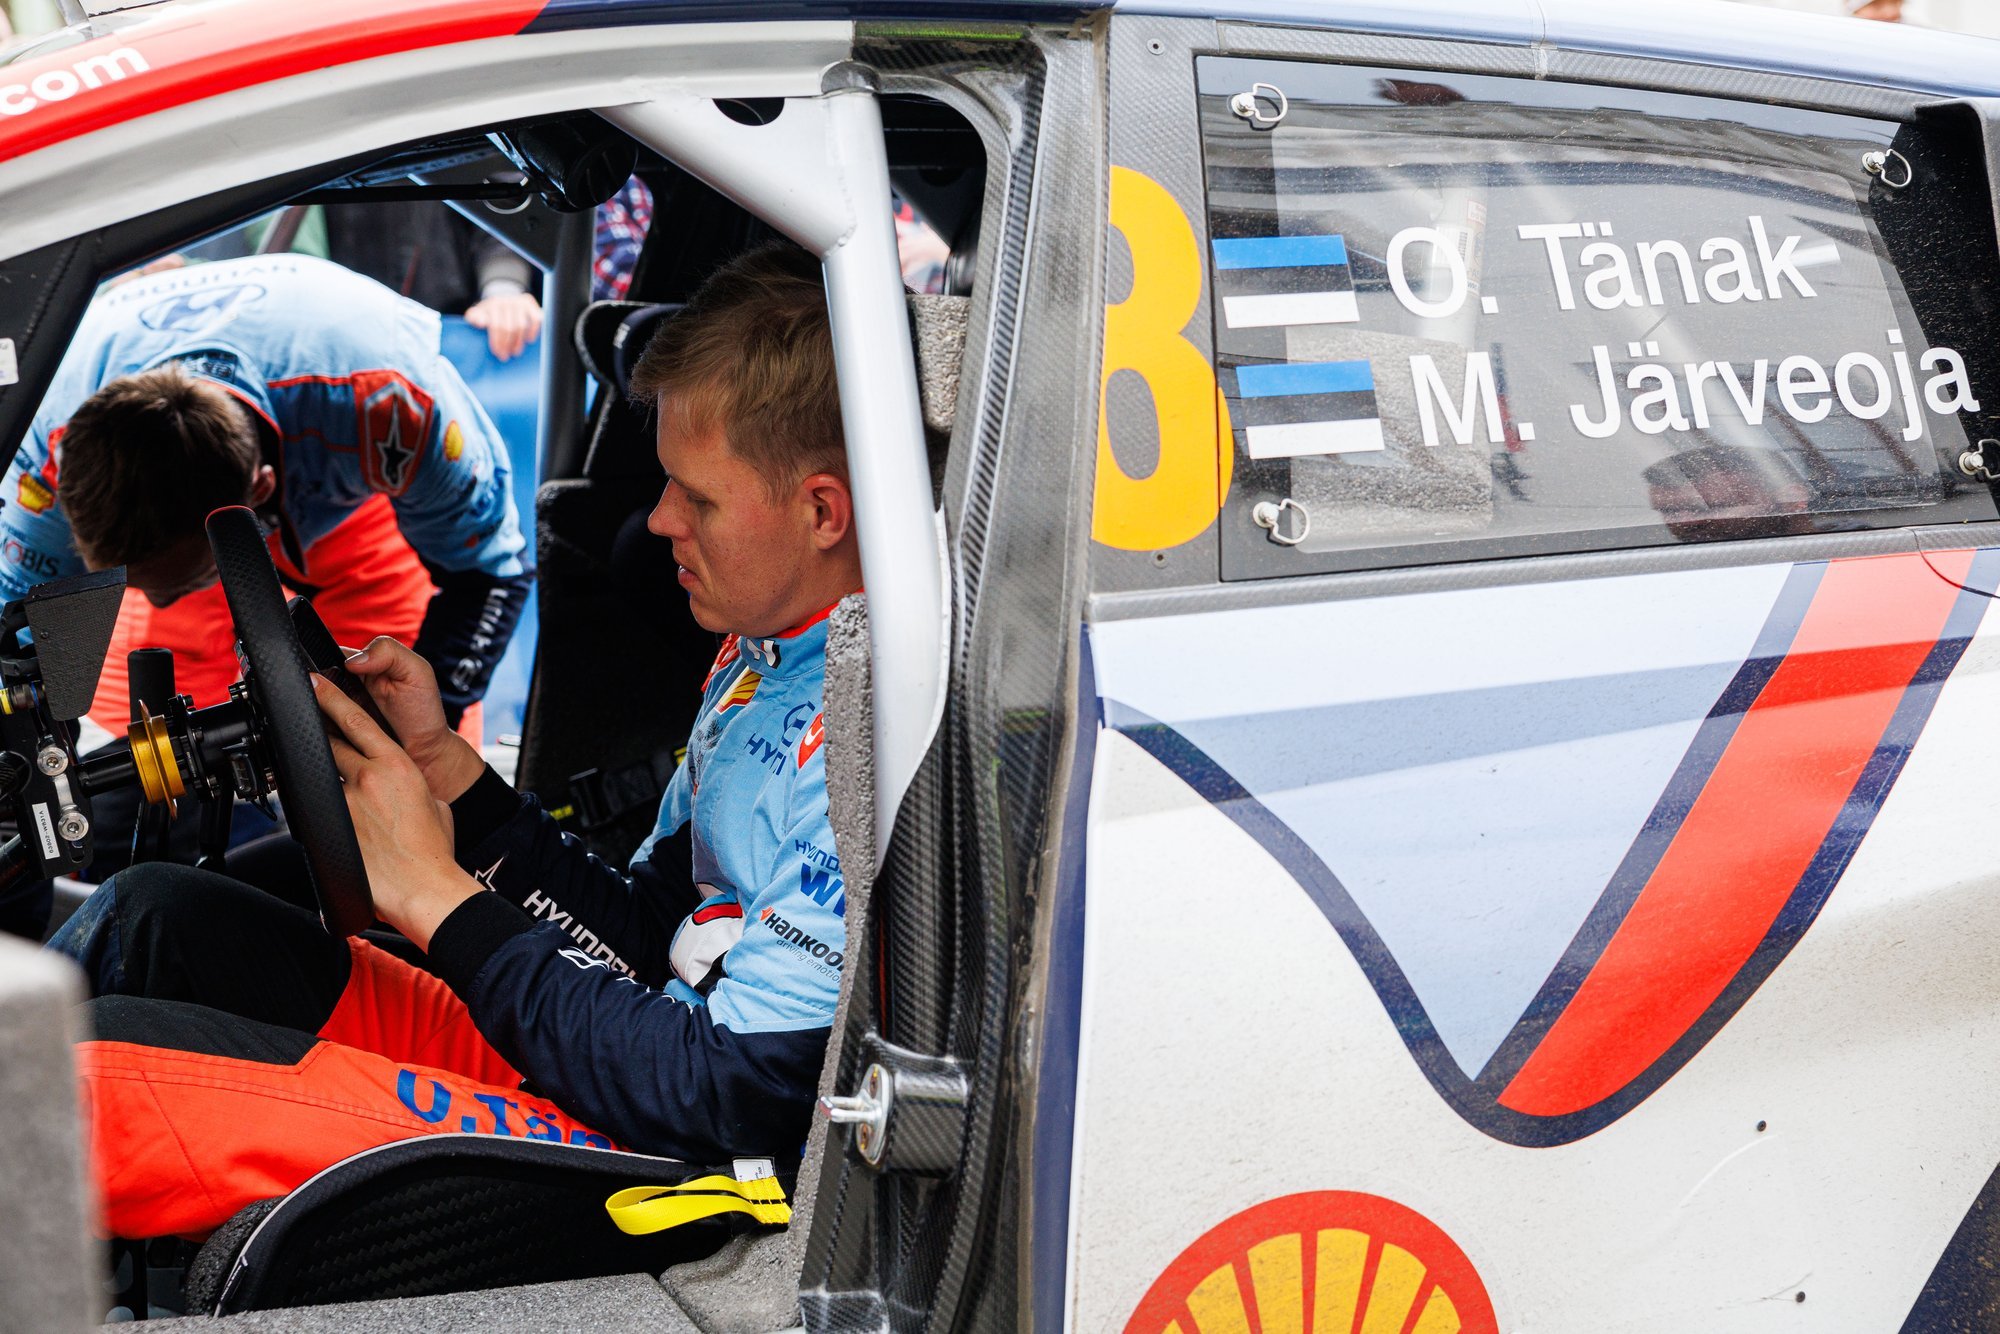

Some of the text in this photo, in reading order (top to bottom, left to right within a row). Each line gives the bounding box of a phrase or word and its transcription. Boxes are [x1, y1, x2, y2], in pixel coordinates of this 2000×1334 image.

[1386, 215, 1818, 318] O. Tänak
[1410, 329, 1981, 448] M. Järveoja
[4, 537, 60, 577] OBIS
[795, 839, 842, 873] HYUND
[776, 938, 807, 962] driving
